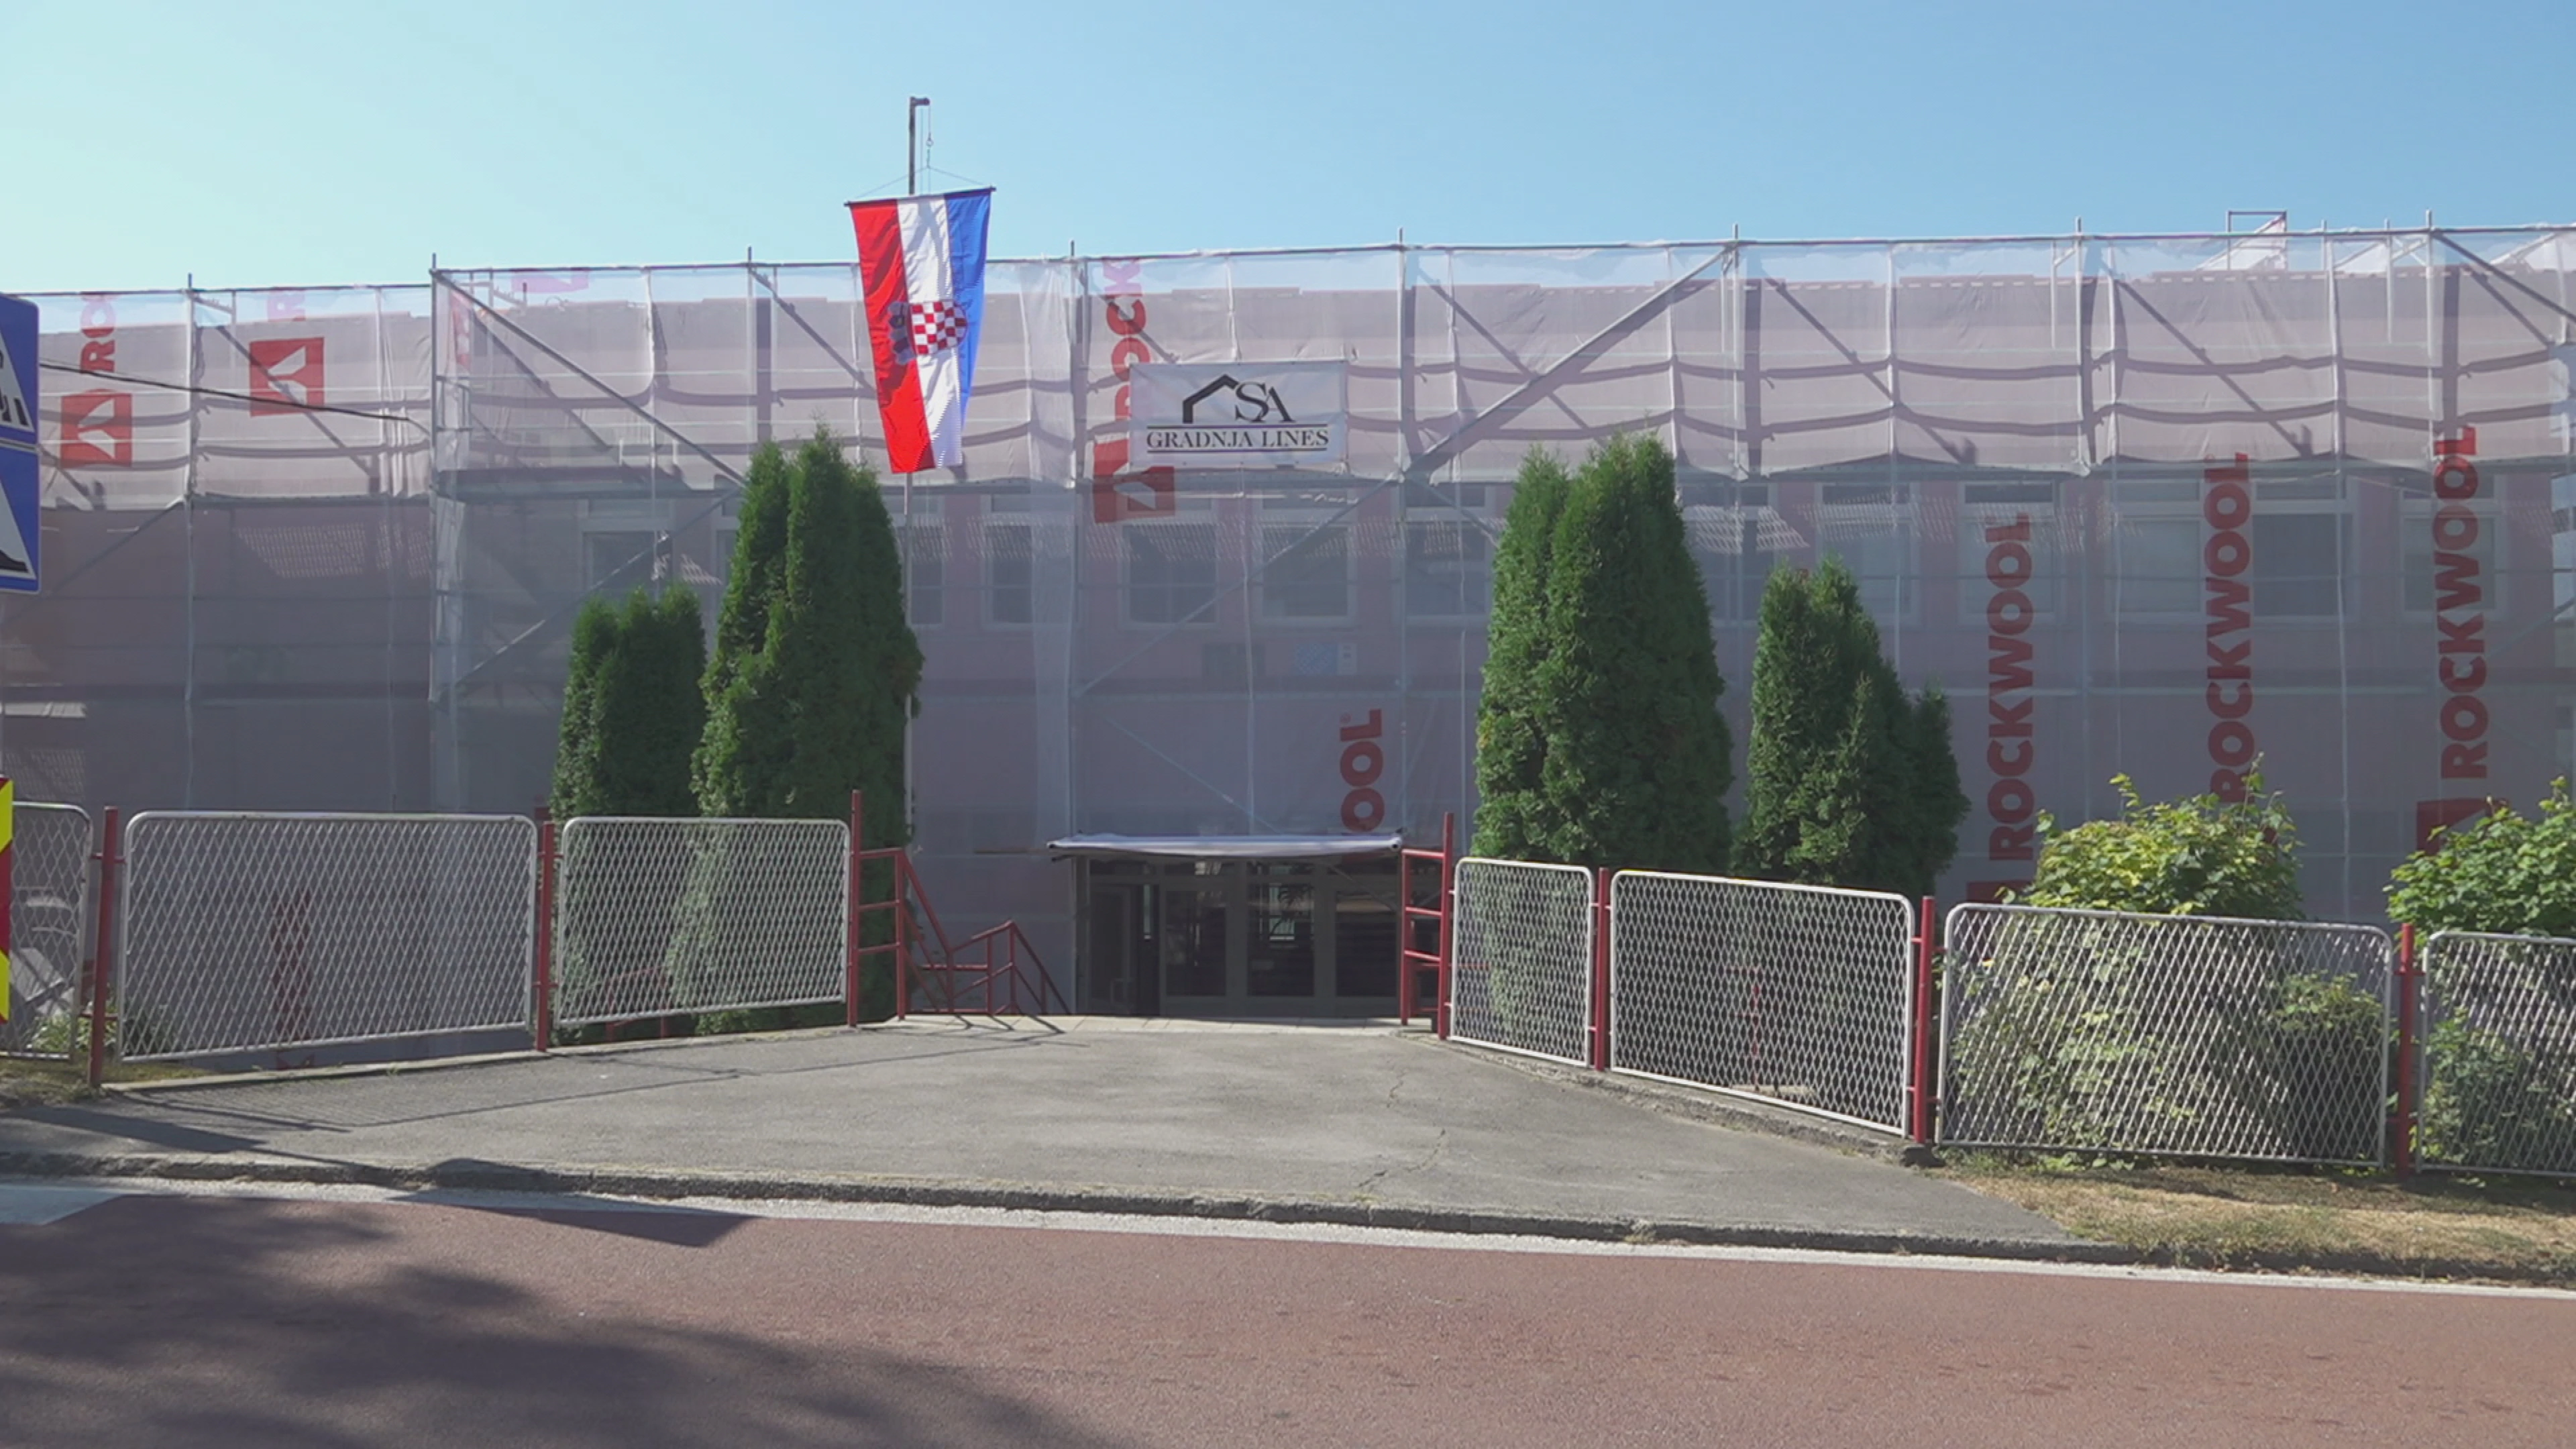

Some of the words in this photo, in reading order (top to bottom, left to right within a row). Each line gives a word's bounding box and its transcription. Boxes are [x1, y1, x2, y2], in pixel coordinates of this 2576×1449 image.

[1146, 429, 1254, 449] GRADNJA
[1260, 427, 1330, 447] LINES
[2432, 425, 2489, 780] ROCKWOOL
[1985, 511, 2035, 861] ROCKWOOL
[2203, 451, 2255, 804] ROCKWOOL
